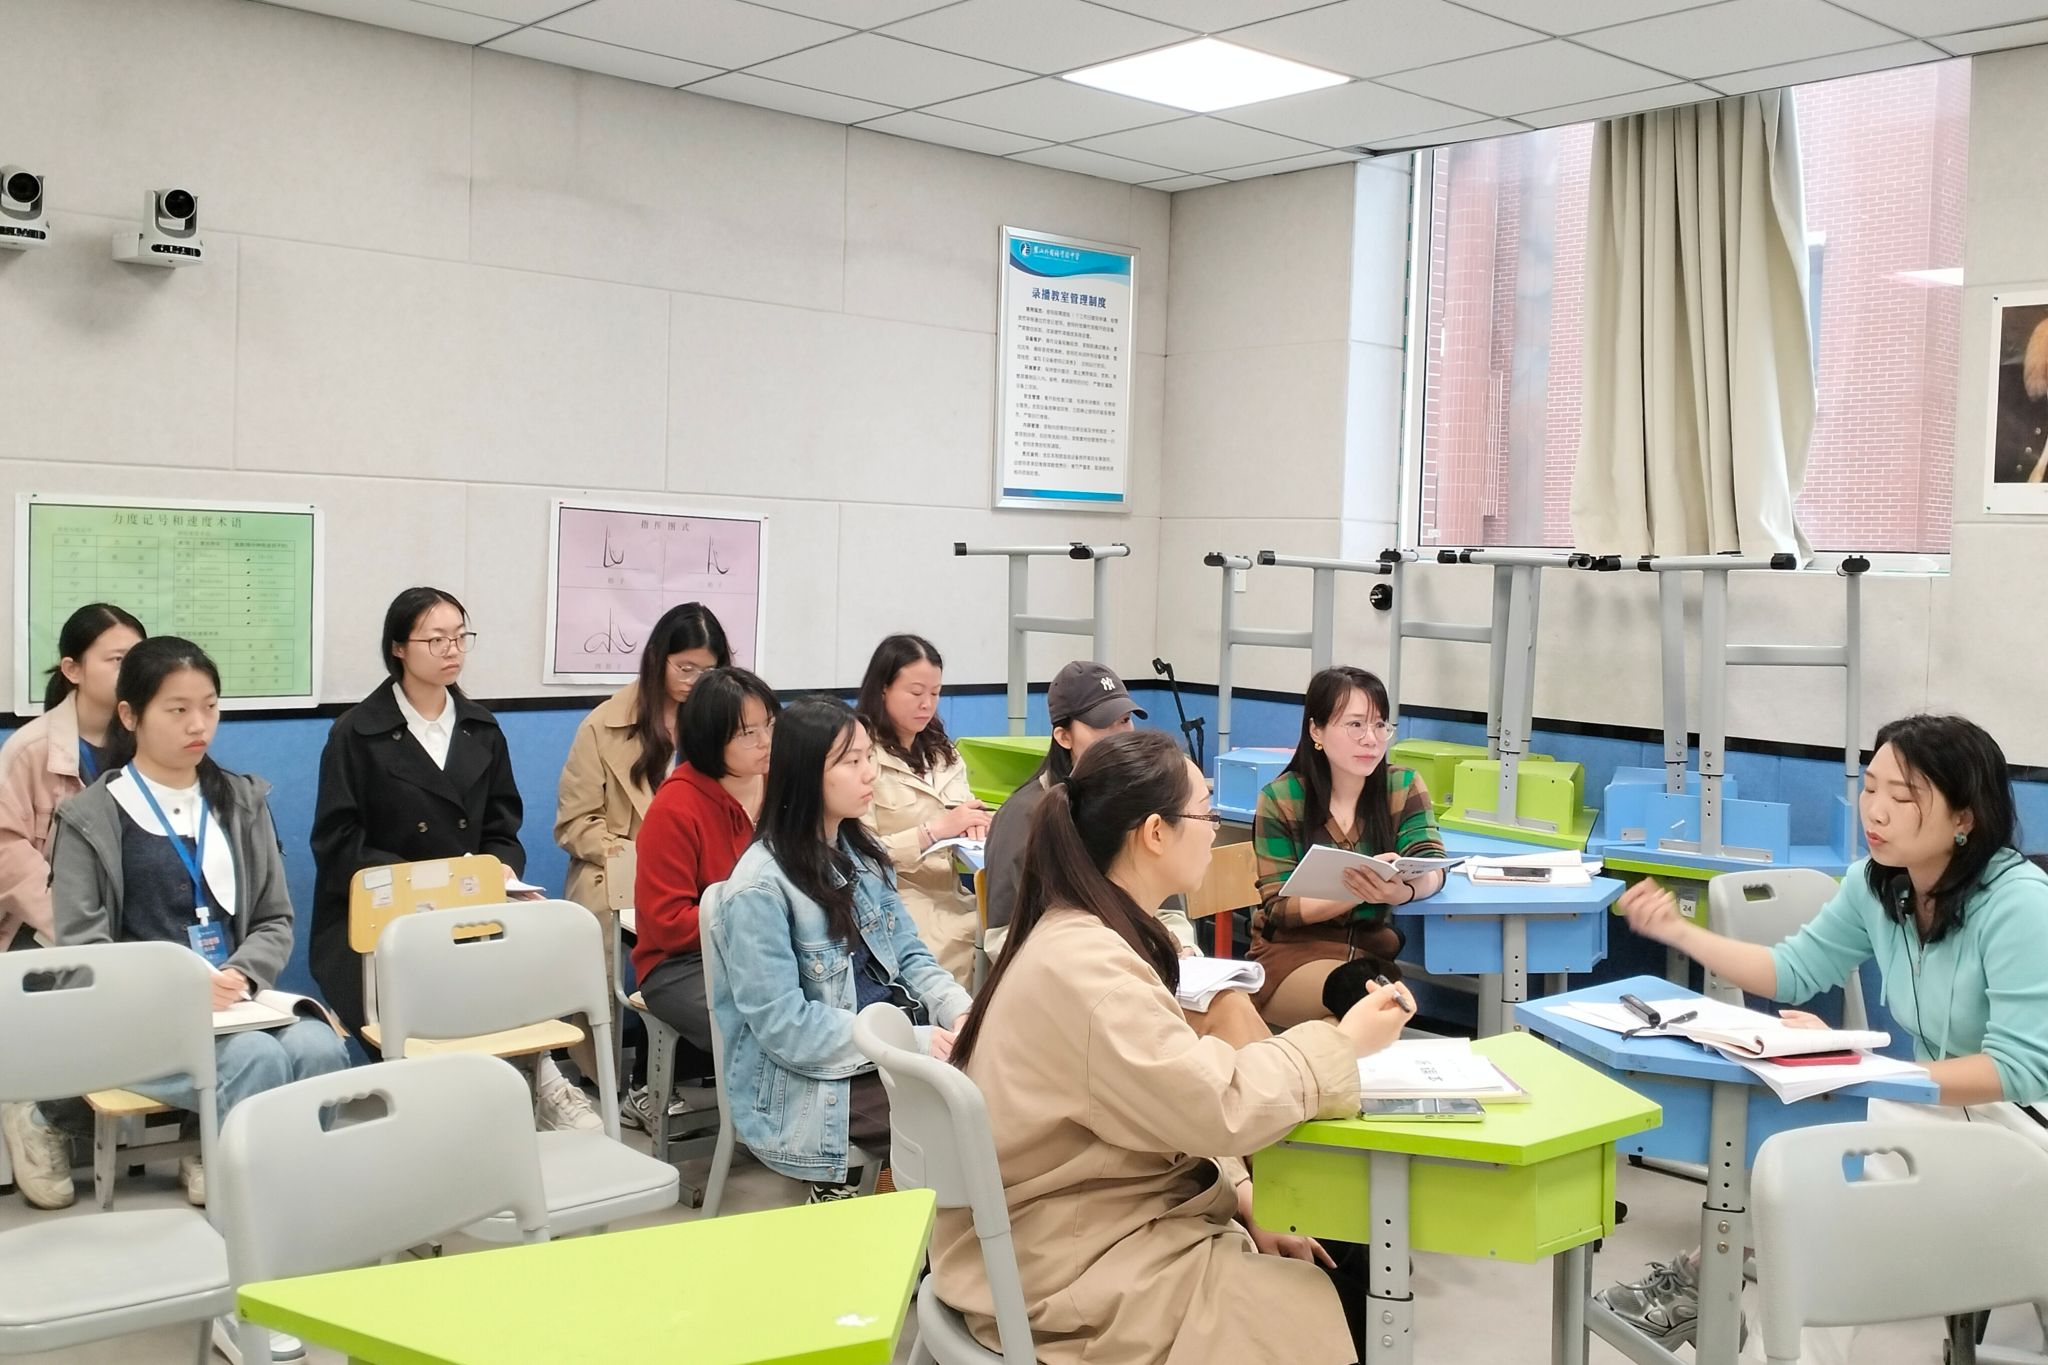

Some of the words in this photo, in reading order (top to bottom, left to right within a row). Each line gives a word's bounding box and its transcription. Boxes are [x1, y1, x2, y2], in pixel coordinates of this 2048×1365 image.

[1032, 287, 1106, 309] 录播教室管理制度
[112, 512, 243, 529] 力度记号和速度术语
[1682, 904, 1692, 912] 24
